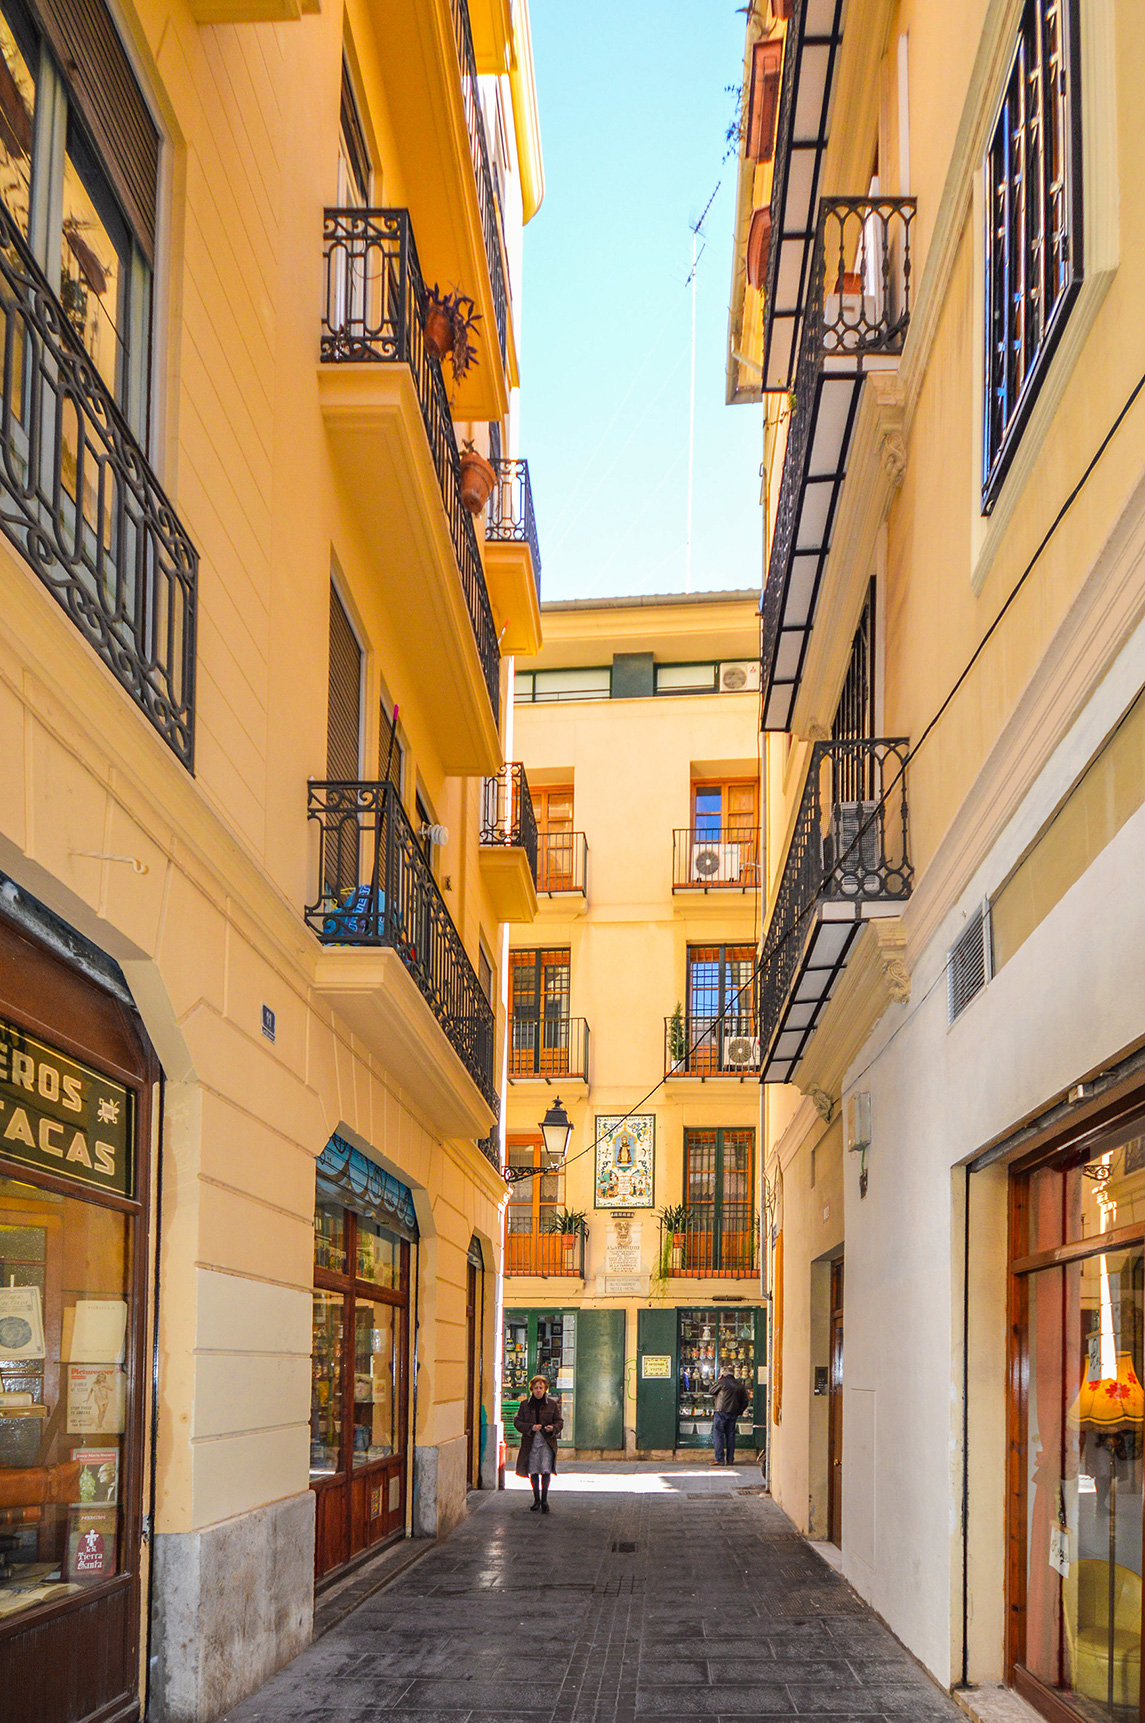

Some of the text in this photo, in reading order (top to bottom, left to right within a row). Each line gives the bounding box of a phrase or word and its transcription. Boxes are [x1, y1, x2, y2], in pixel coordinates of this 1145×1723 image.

[0, 1101, 115, 1176] ACAS
[78, 1552, 103, 1561] Tierra
[77, 1560, 103, 1570] Santa
